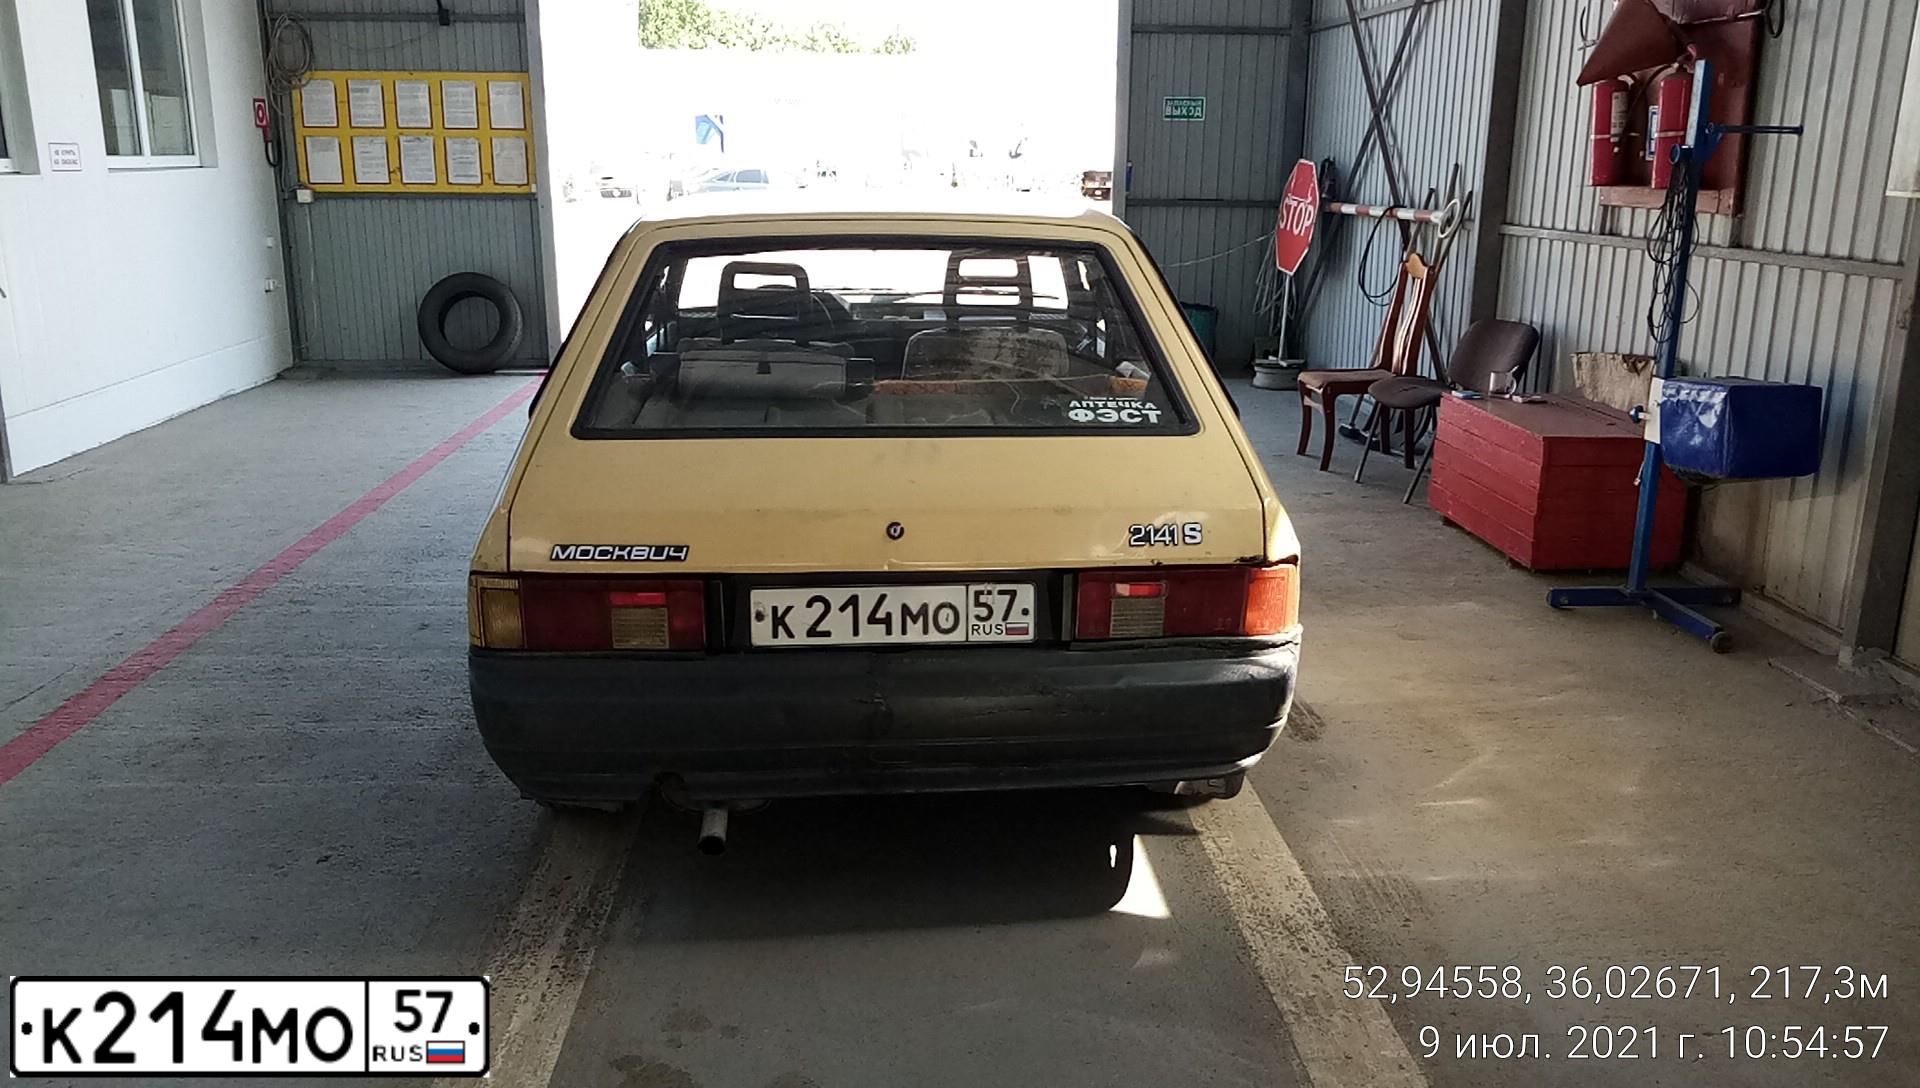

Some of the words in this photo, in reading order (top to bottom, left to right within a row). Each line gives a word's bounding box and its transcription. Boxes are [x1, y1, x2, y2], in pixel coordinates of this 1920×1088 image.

[1165, 106, 1202, 117] ВЫХОД
[1280, 196, 1314, 236] STOP
[1069, 400, 1157, 409] АПТЕЧКА
[1068, 408, 1162, 424] ФЭСТ
[1128, 524, 1178, 546] 2141
[1183, 523, 1202, 544] S
[551, 545, 688, 561] МОСКВИЧ
[771, 593, 960, 639] К214МО
[973, 589, 1017, 622] 57
[971, 624, 1004, 635] RUS
